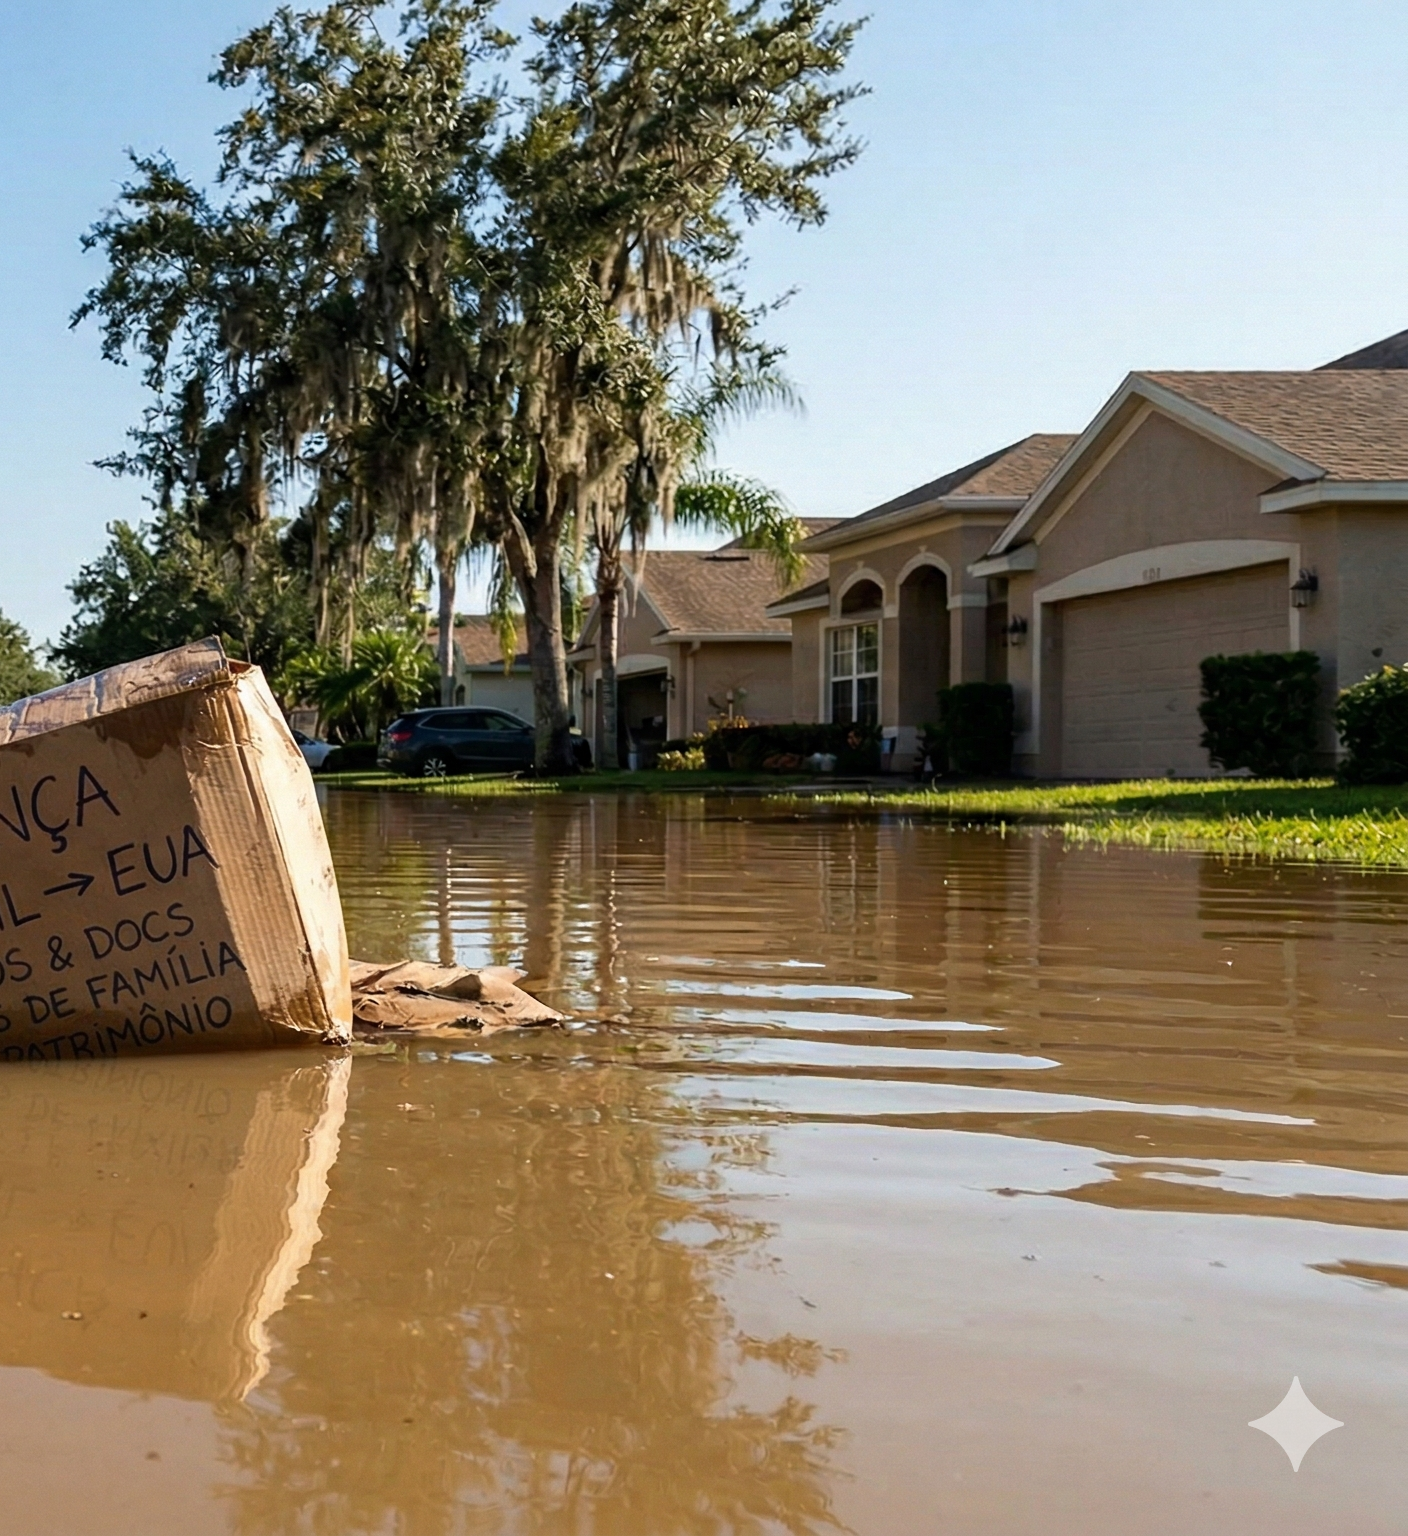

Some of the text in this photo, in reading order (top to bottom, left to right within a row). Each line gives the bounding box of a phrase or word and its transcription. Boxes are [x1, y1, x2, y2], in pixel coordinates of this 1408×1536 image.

[106, 823, 221, 897] EUA
[48, 935, 76, 972] &
[83, 902, 195, 960] DOCS
[22, 987, 76, 1024] DE
[85, 940, 248, 1009] FAMÍLIA
